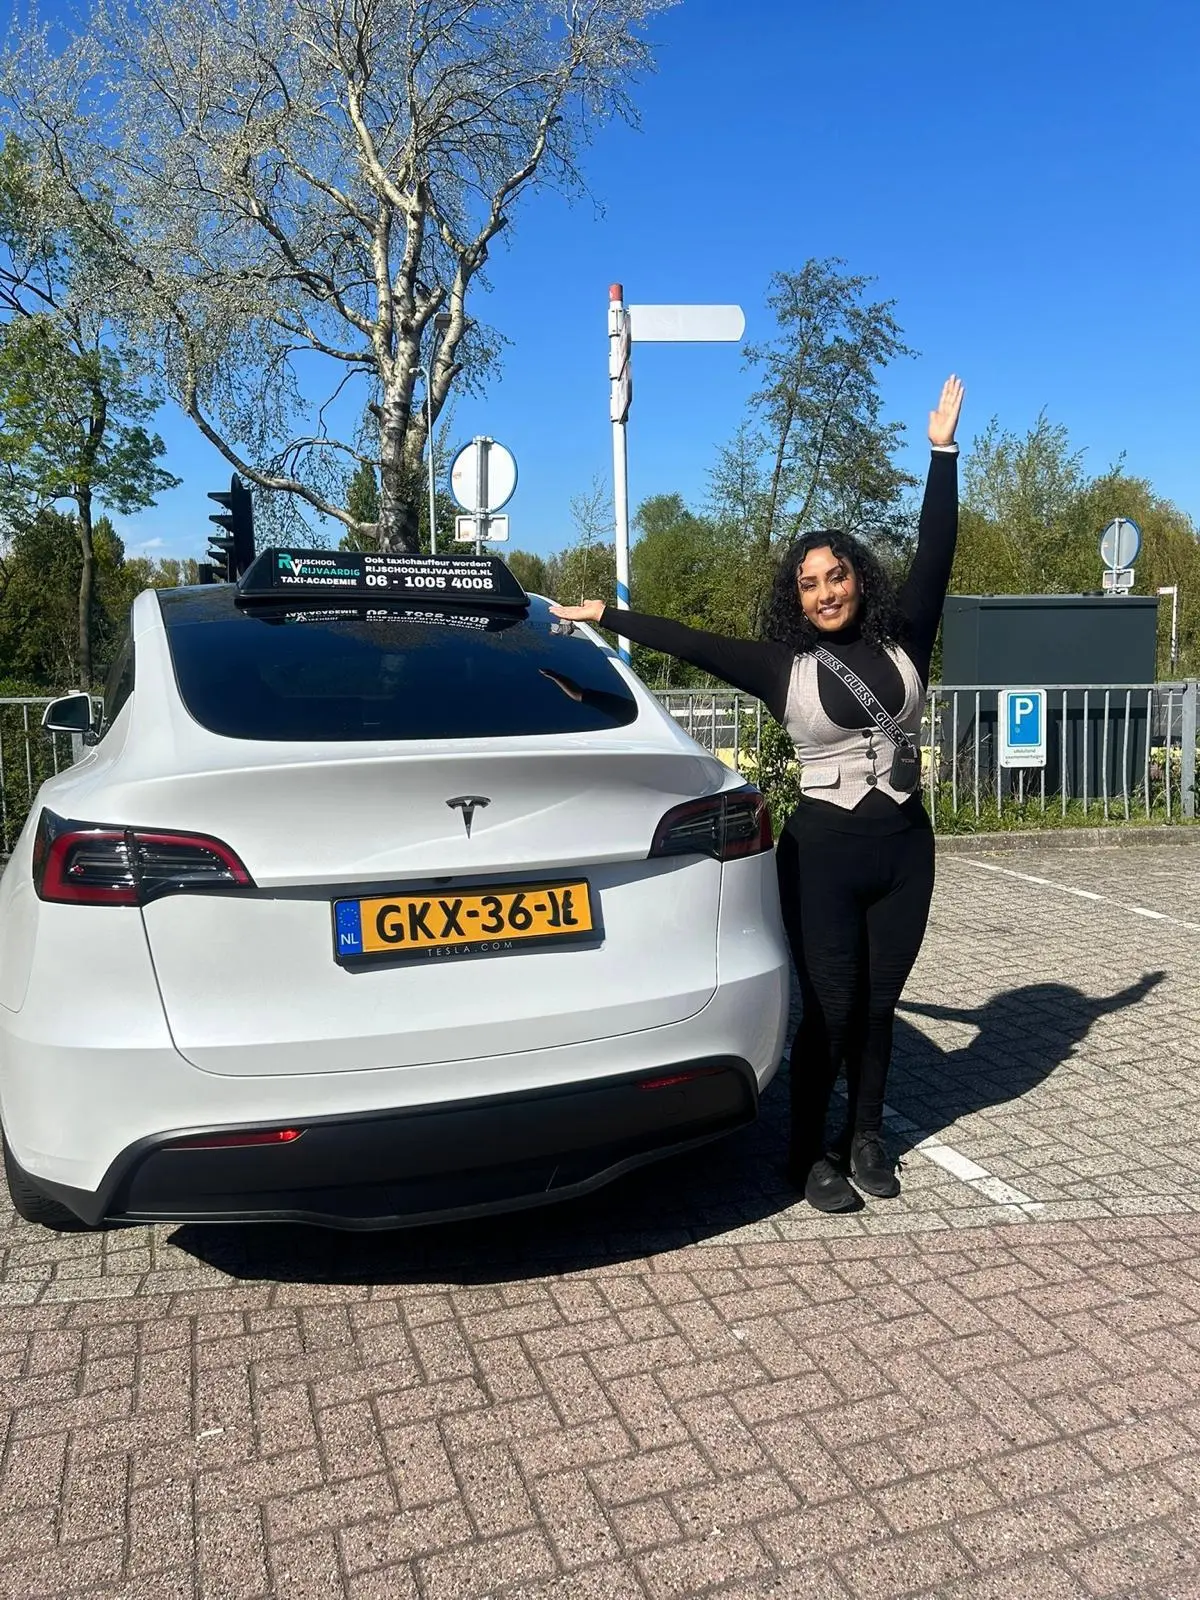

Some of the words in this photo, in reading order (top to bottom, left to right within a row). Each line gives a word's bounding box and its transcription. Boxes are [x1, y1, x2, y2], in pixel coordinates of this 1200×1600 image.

[294, 558, 337, 566] RIJSCHOOL
[364, 556, 384, 564] Ook
[386, 557, 450, 567] taxichauffeur
[452, 560, 492, 568] worden?
[365, 565, 493, 576] RIJSCHOOLRIJVAARDIG.NL
[280, 576, 357, 586] TAXI-ACADEMIE
[365, 574, 388, 587] 06
[404, 576, 446, 588] 1005
[451, 577, 493, 589] 4008
[815, 649, 843, 671] GUESS
[843, 673, 875, 707] GUESS
[1015, 697, 1034, 725] P
[340, 933, 360, 946] NL
[427, 941, 514, 957] TESLA.COM
